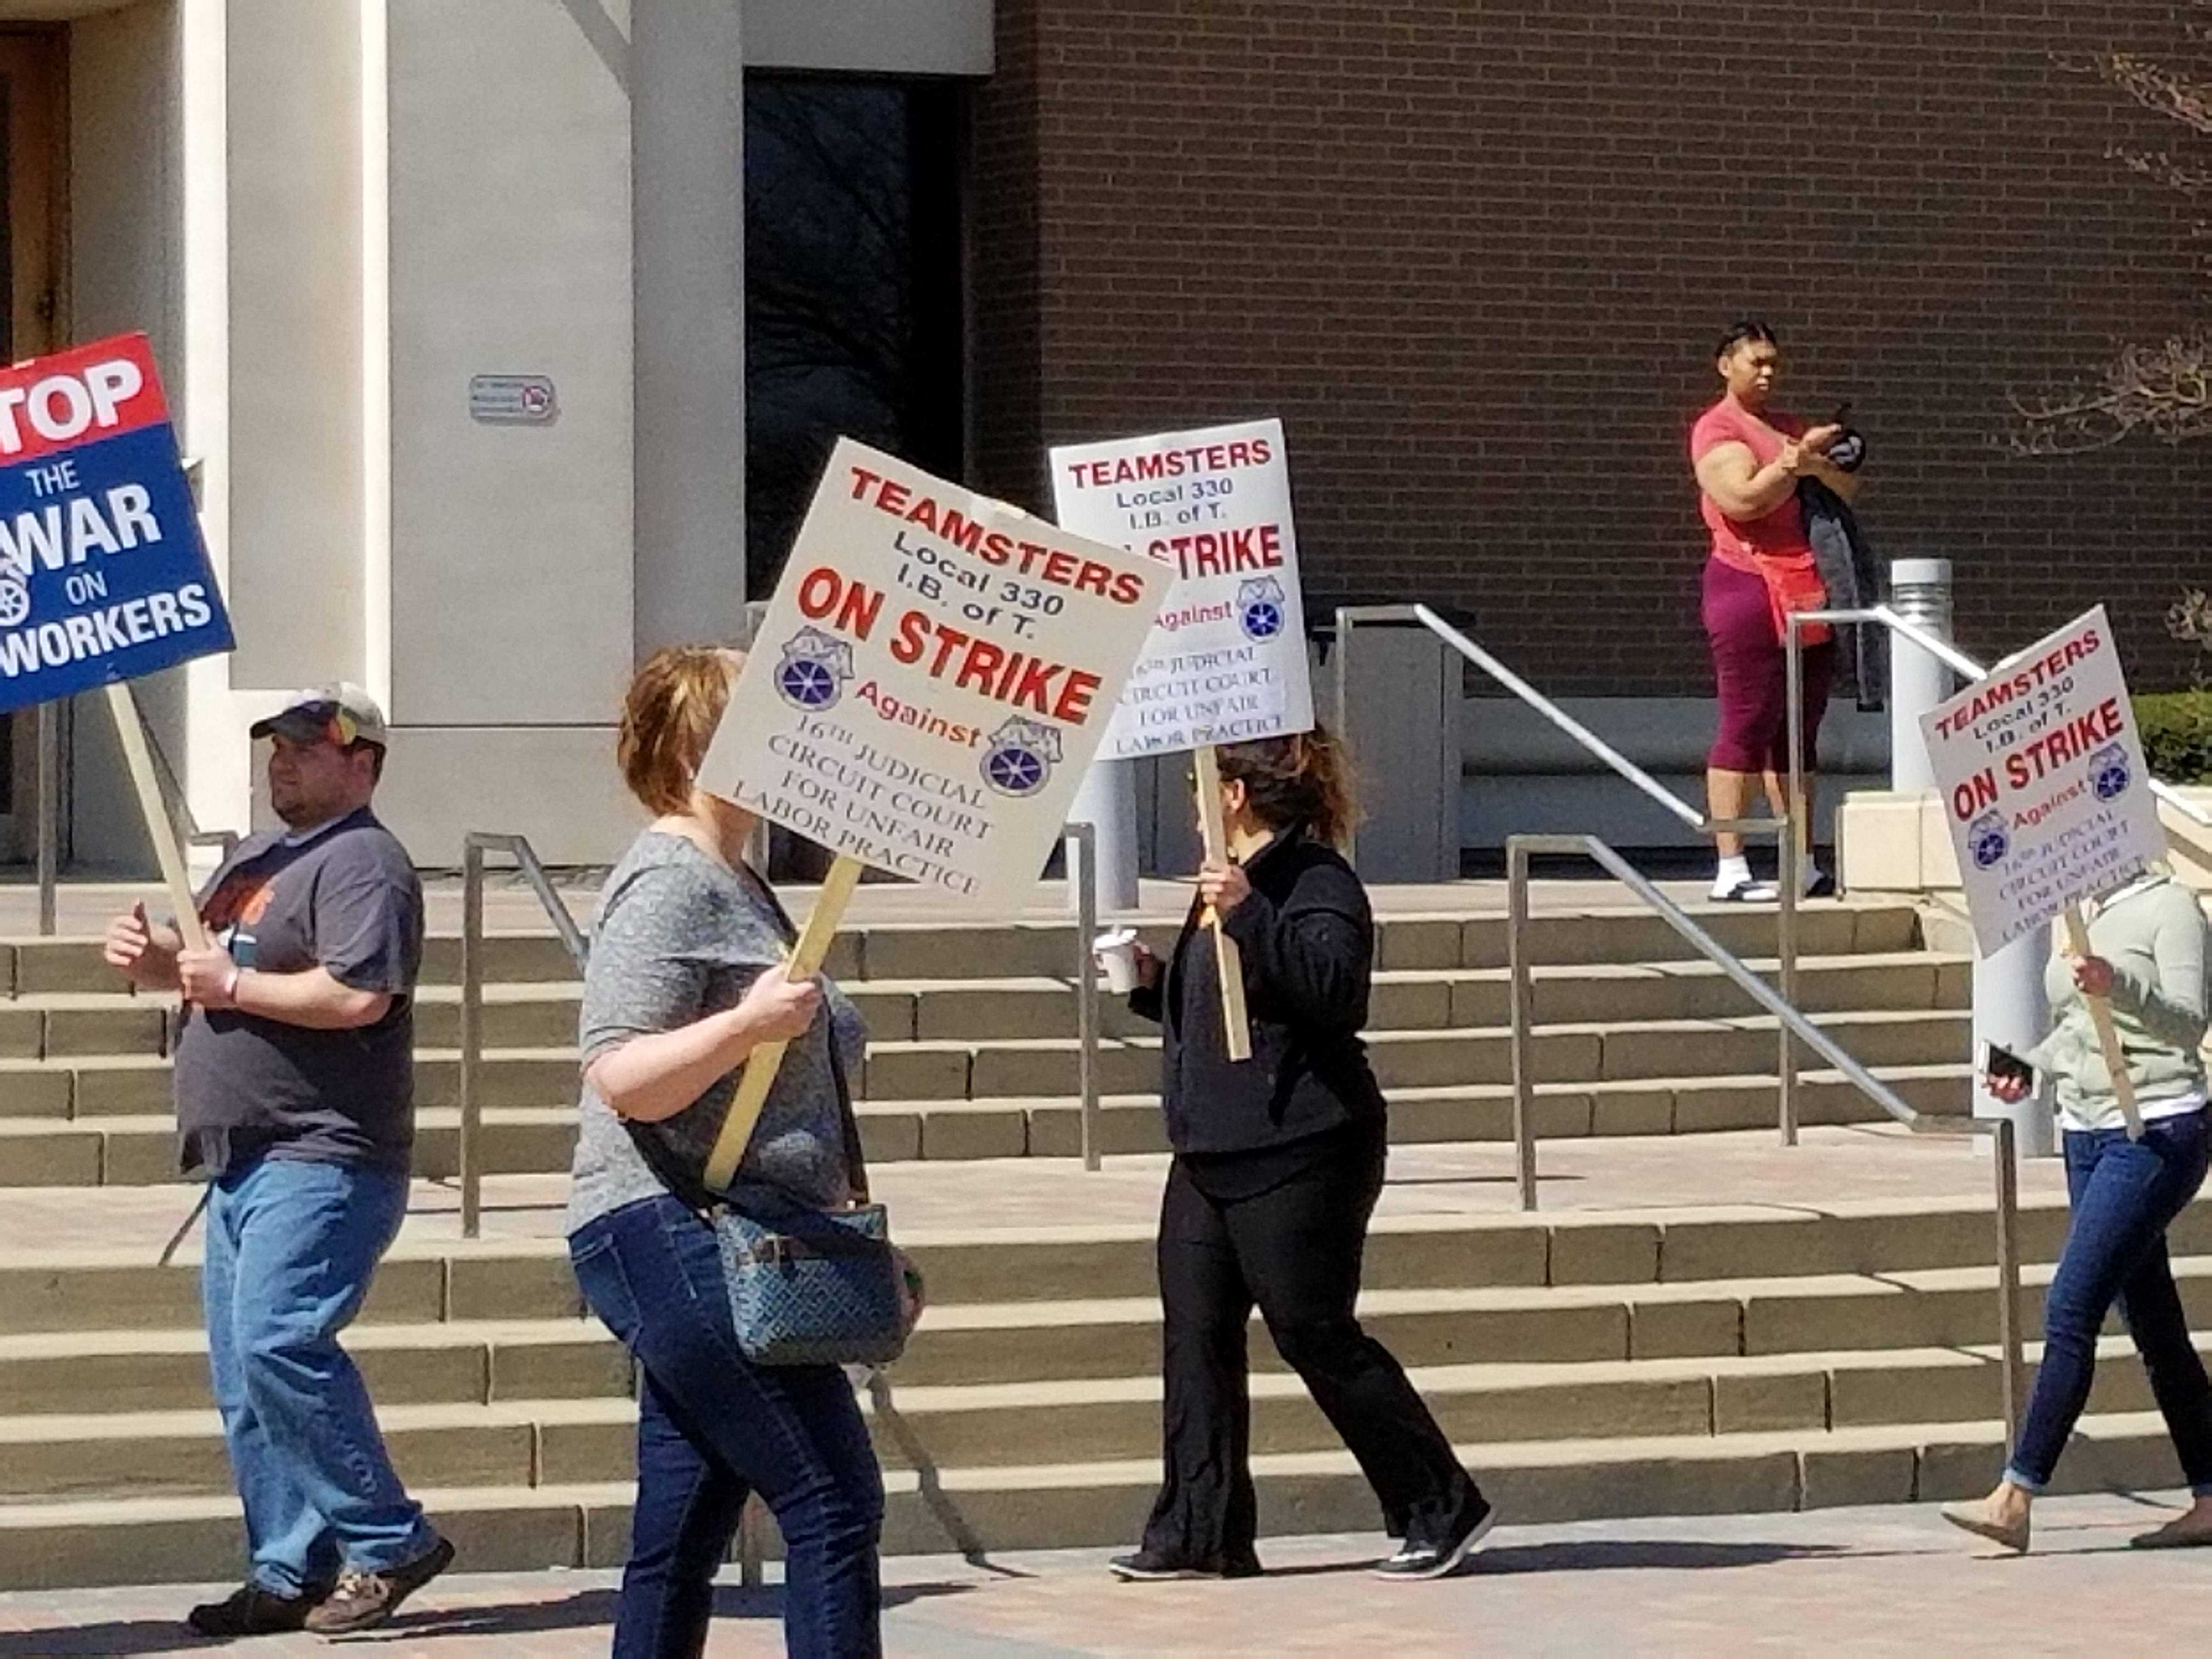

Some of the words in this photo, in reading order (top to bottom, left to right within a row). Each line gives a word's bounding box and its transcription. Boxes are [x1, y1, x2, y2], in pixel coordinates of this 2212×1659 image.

[0, 359, 143, 454] TOP
[26, 460, 80, 497] THE
[1068, 439, 1272, 488] TEAMSTERS
[1116, 485, 1183, 509] Local
[1192, 477, 1233, 499] 330
[0, 482, 162, 577] WAR
[850, 466, 1145, 605] TEAMSTERS
[1177, 503, 1200, 524] of
[65, 571, 108, 605] ON
[893, 530, 988, 594] Local
[1000, 581, 1064, 617] 330
[896, 563, 948, 609] I.B.
[962, 601, 999, 627] of
[1009, 613, 1037, 640] T.
[0, 584, 212, 678] WORKERS
[797, 567, 885, 642] ON
[889, 610, 1103, 727] STRIKE
[856, 680, 983, 750] Against
[1935, 629, 2101, 741] TEAMSTERS
[1974, 700, 2033, 740] Local
[768, 734, 883, 801] CIRCUIT
[891, 790, 995, 840] COURT
[855, 742, 987, 810] JUDICIAL
[1954, 768, 1999, 822] ON
[2005, 696, 2124, 790] STRIKE
[732, 780, 832, 840] LABOR
[837, 829, 981, 895] PRACTICE
[781, 770, 837, 810] FOR
[846, 801, 955, 858] UNFAIR
[2013, 780, 2087, 831] Against
